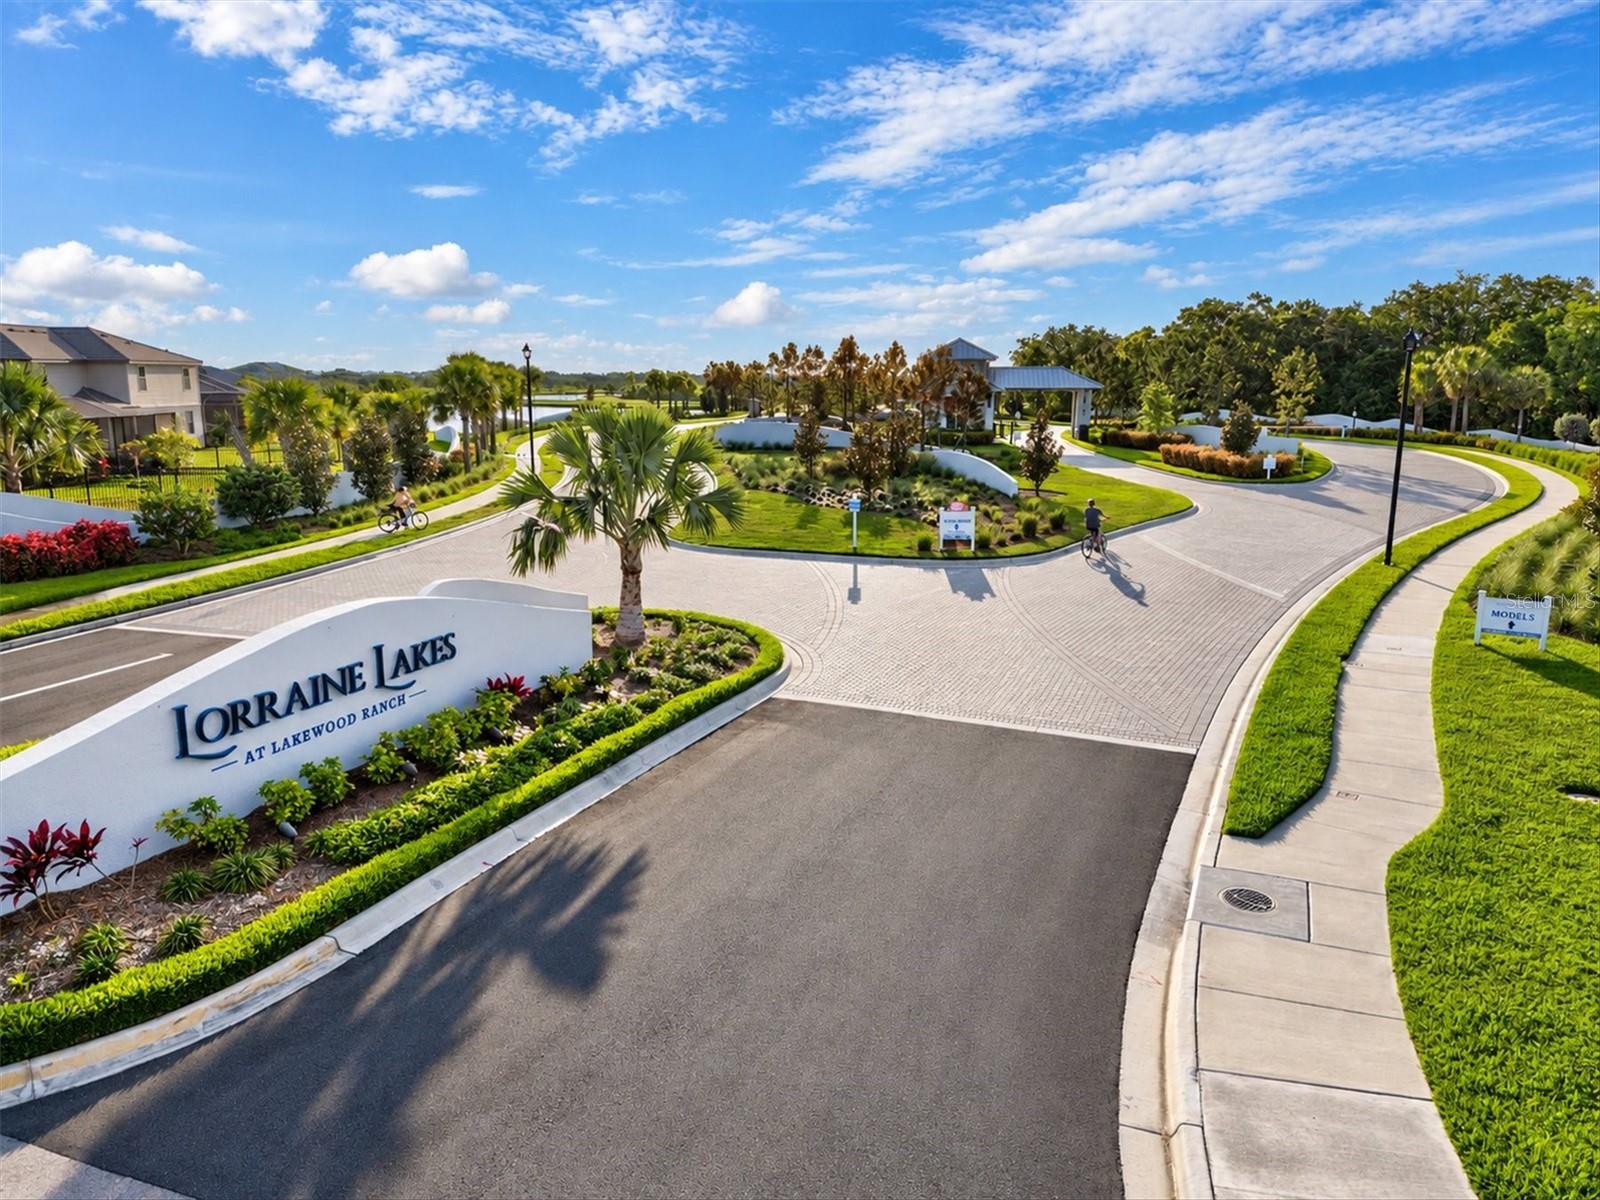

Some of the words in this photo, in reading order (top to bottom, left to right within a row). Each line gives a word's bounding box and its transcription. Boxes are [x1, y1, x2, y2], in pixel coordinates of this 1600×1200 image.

[1491, 610, 1535, 621] MODELS
[172, 661, 366, 760] LORRAINE
[373, 632, 457, 690] LAKES
[244, 749, 266, 765] AT
[271, 714, 357, 755] LAKEWOOD
[361, 693, 407, 720] RANCH
